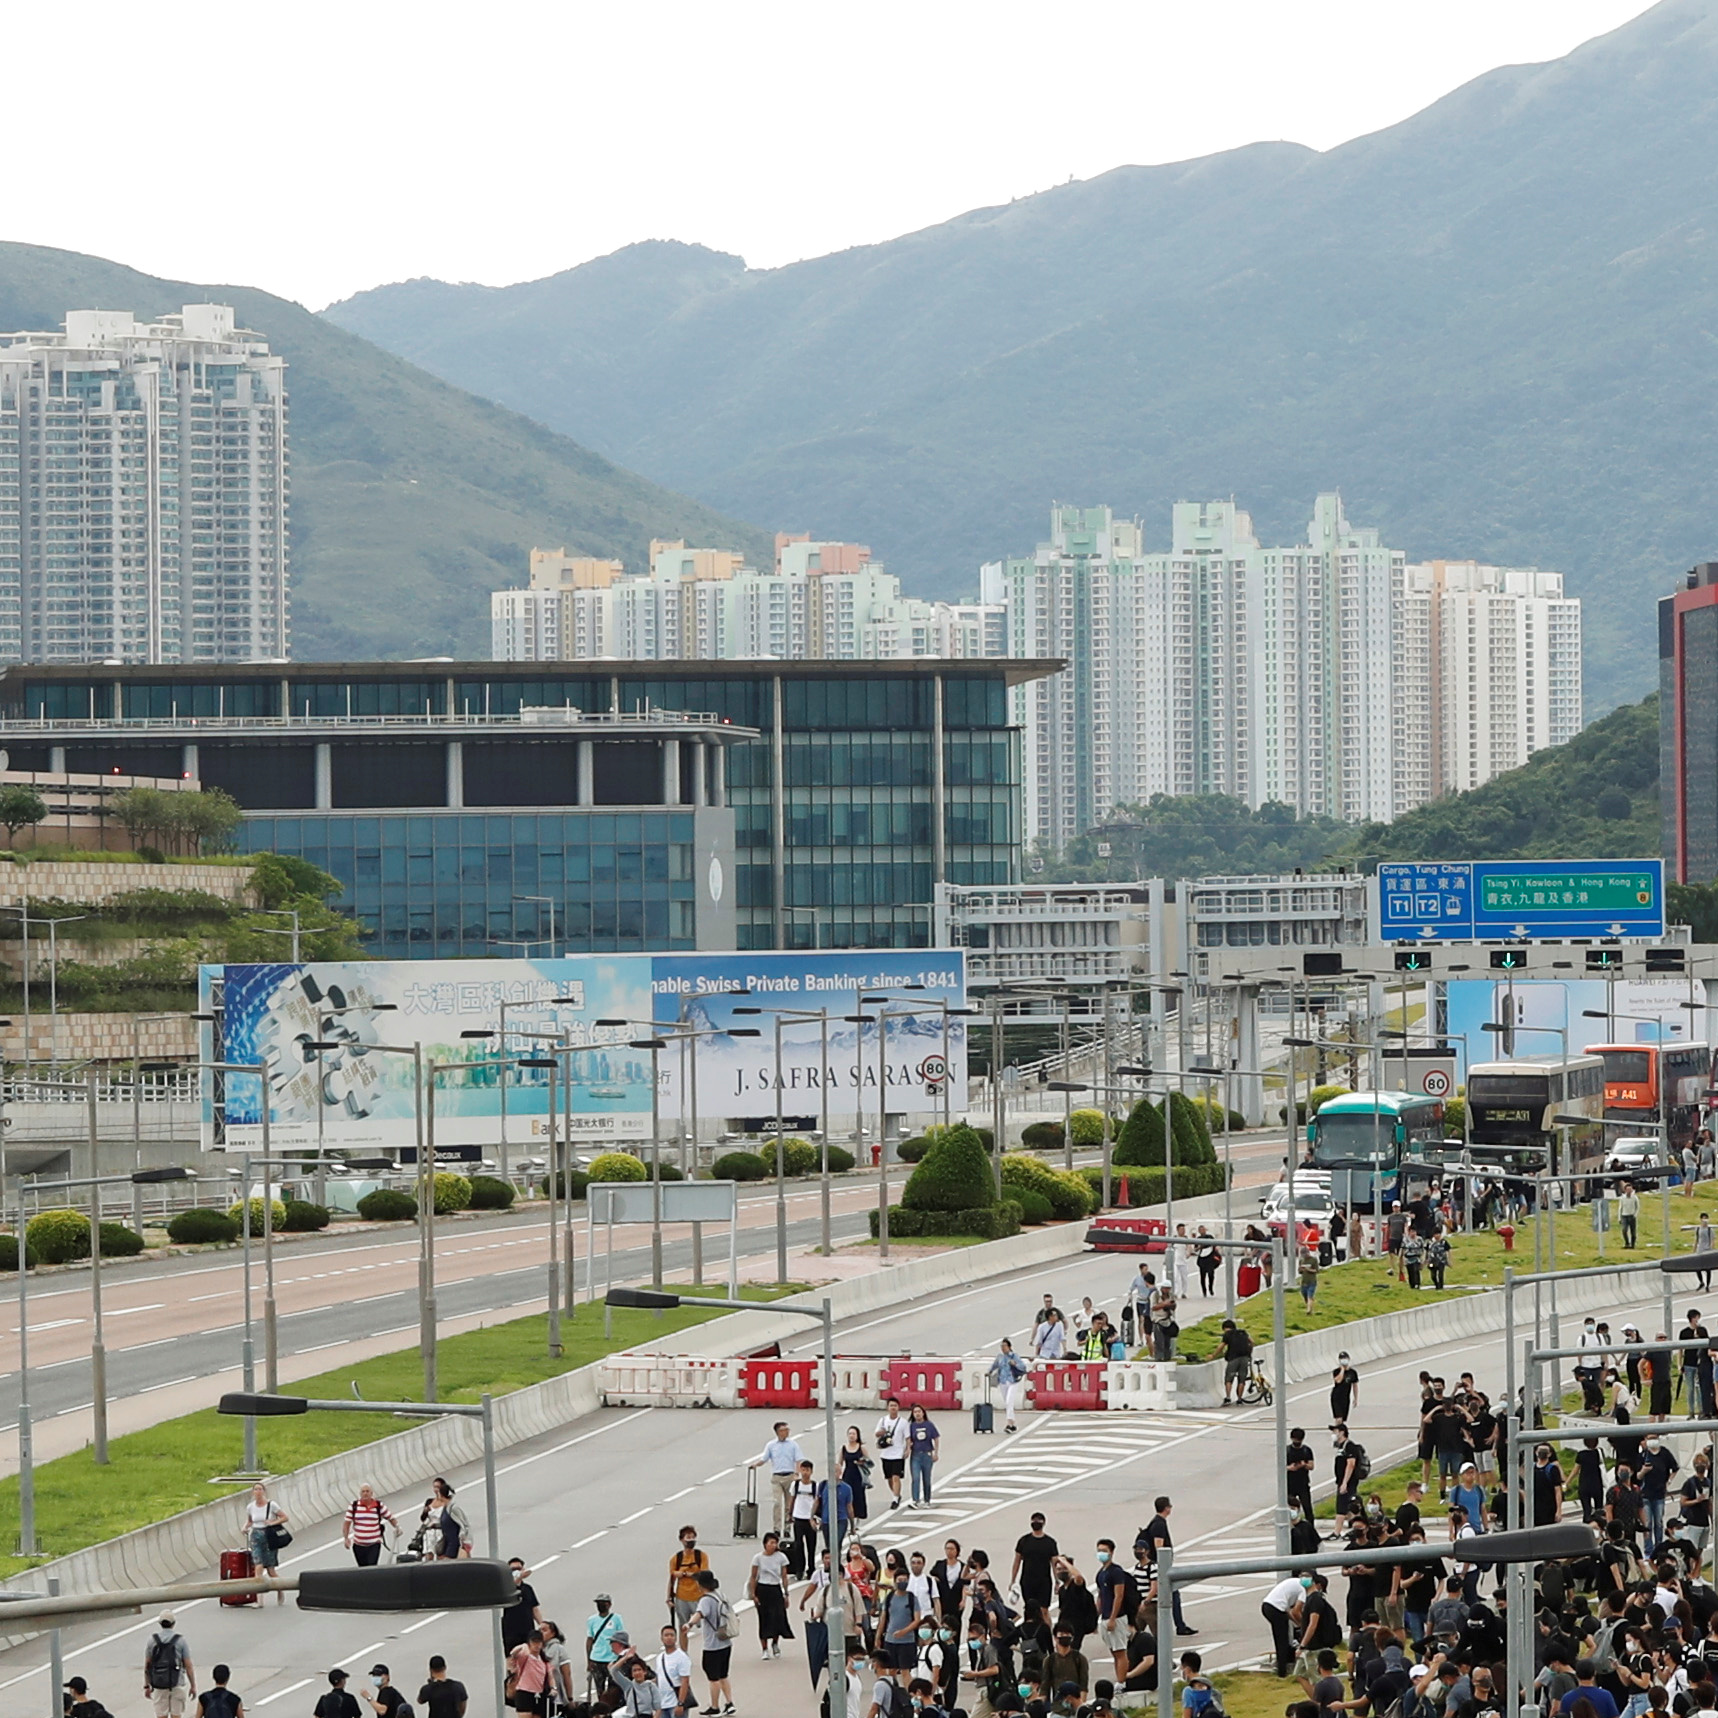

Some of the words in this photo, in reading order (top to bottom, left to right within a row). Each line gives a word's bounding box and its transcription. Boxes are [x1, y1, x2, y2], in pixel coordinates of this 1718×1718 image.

[1381, 866, 1411, 875] Cargo,
[1415, 866, 1437, 875] Tung
[1441, 865, 1470, 875] Chung
[1486, 879, 1508, 889] Tsing
[1511, 879, 1523, 888] Yi,
[1526, 878, 1563, 887] Kowloon
[1569, 878, 1575, 886] &
[1581, 878, 1603, 888] Hong
[1609, 878, 1631, 888] Kong
[1393, 900, 1409, 912] T1
[1419, 900, 1438, 912] T2
[696, 975, 741, 993] Swiss
[746, 975, 799, 992] Private
[805, 973, 867, 993] Banking
[872, 974, 911, 989] since
[917, 971, 957, 989] 1841
[926, 1063, 944, 1074] 80
[735, 1069, 749, 1097] J.
[1427, 1079, 1445, 1090] 80
[1621, 1089, 1637, 1100] A41
